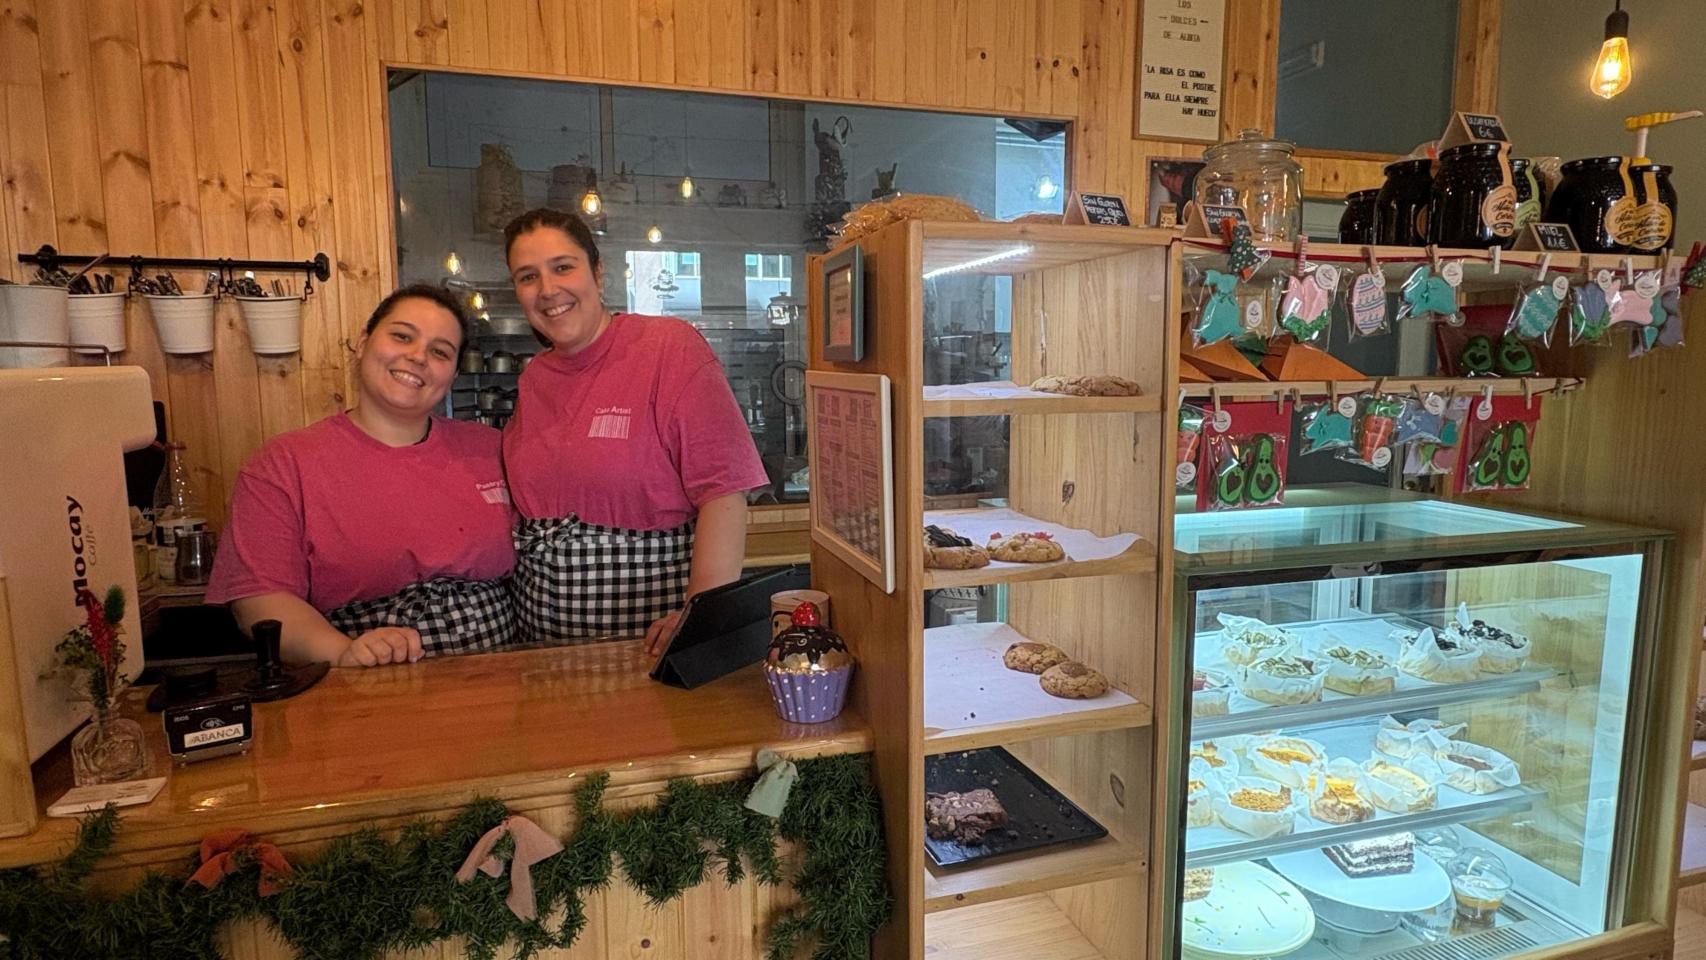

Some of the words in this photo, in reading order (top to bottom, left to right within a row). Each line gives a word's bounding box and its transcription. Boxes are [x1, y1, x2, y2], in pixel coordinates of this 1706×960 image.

[1177, 0, 1192, 9] LOS
[1170, 15, 1198, 26] DULCES
[1163, 31, 1172, 40] DE
[1159, 66, 1174, 75] RISA
[1177, 68, 1186, 77] ES
[1189, 70, 1207, 79] COMO
[1181, 81, 1188, 89] EL
[1144, 91, 1161, 101] PARA
[1165, 93, 1181, 102] ELLA
[1184, 95, 1209, 105] SIEMPRE
[1182, 107, 1194, 115] HAY
[66, 496, 88, 607] mocay
[192, 728, 241, 744] ABANCA
